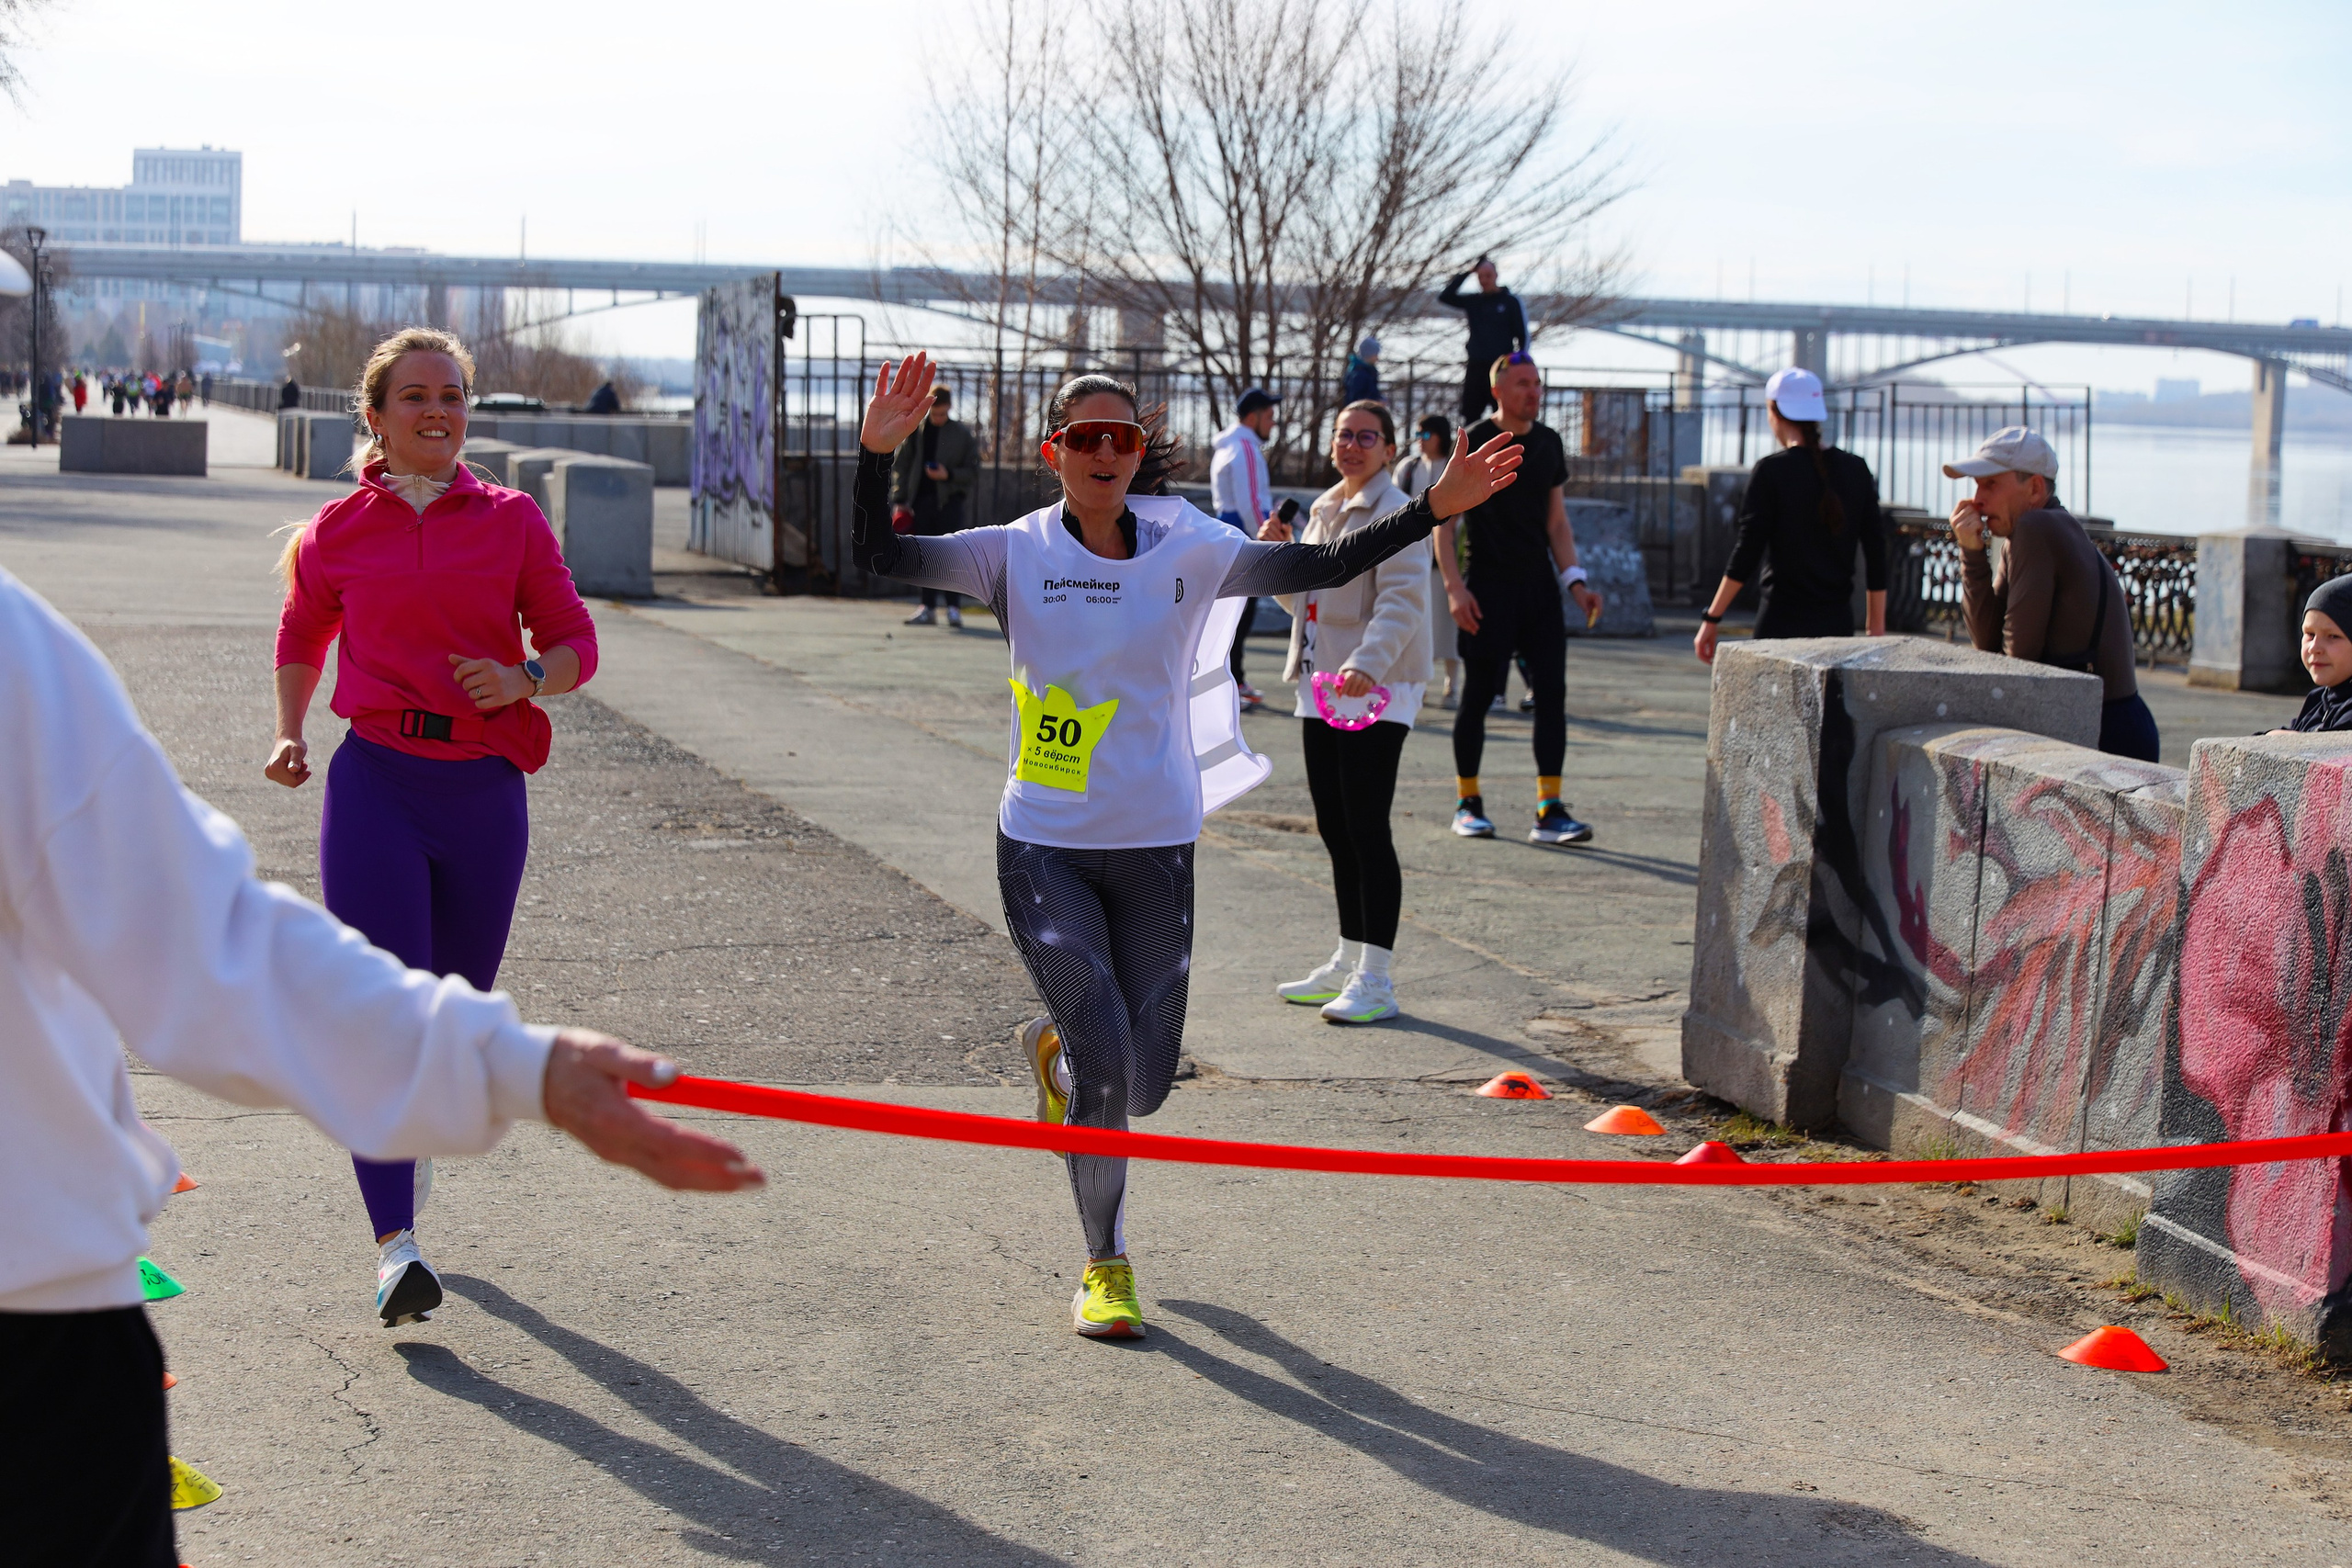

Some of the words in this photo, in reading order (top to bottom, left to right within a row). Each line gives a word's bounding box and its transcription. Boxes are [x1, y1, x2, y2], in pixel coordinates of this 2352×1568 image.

[1044, 577, 1120, 592] Пейсмейкер
[1043, 594, 1067, 604] 30:00
[1085, 595, 1112, 604] 06:00
[1036, 714, 1082, 747] 50
[1035, 746, 1042, 756] 5
[1044, 749, 1080, 764] вёрст
[1023, 757, 1081, 775] Новосибирск
